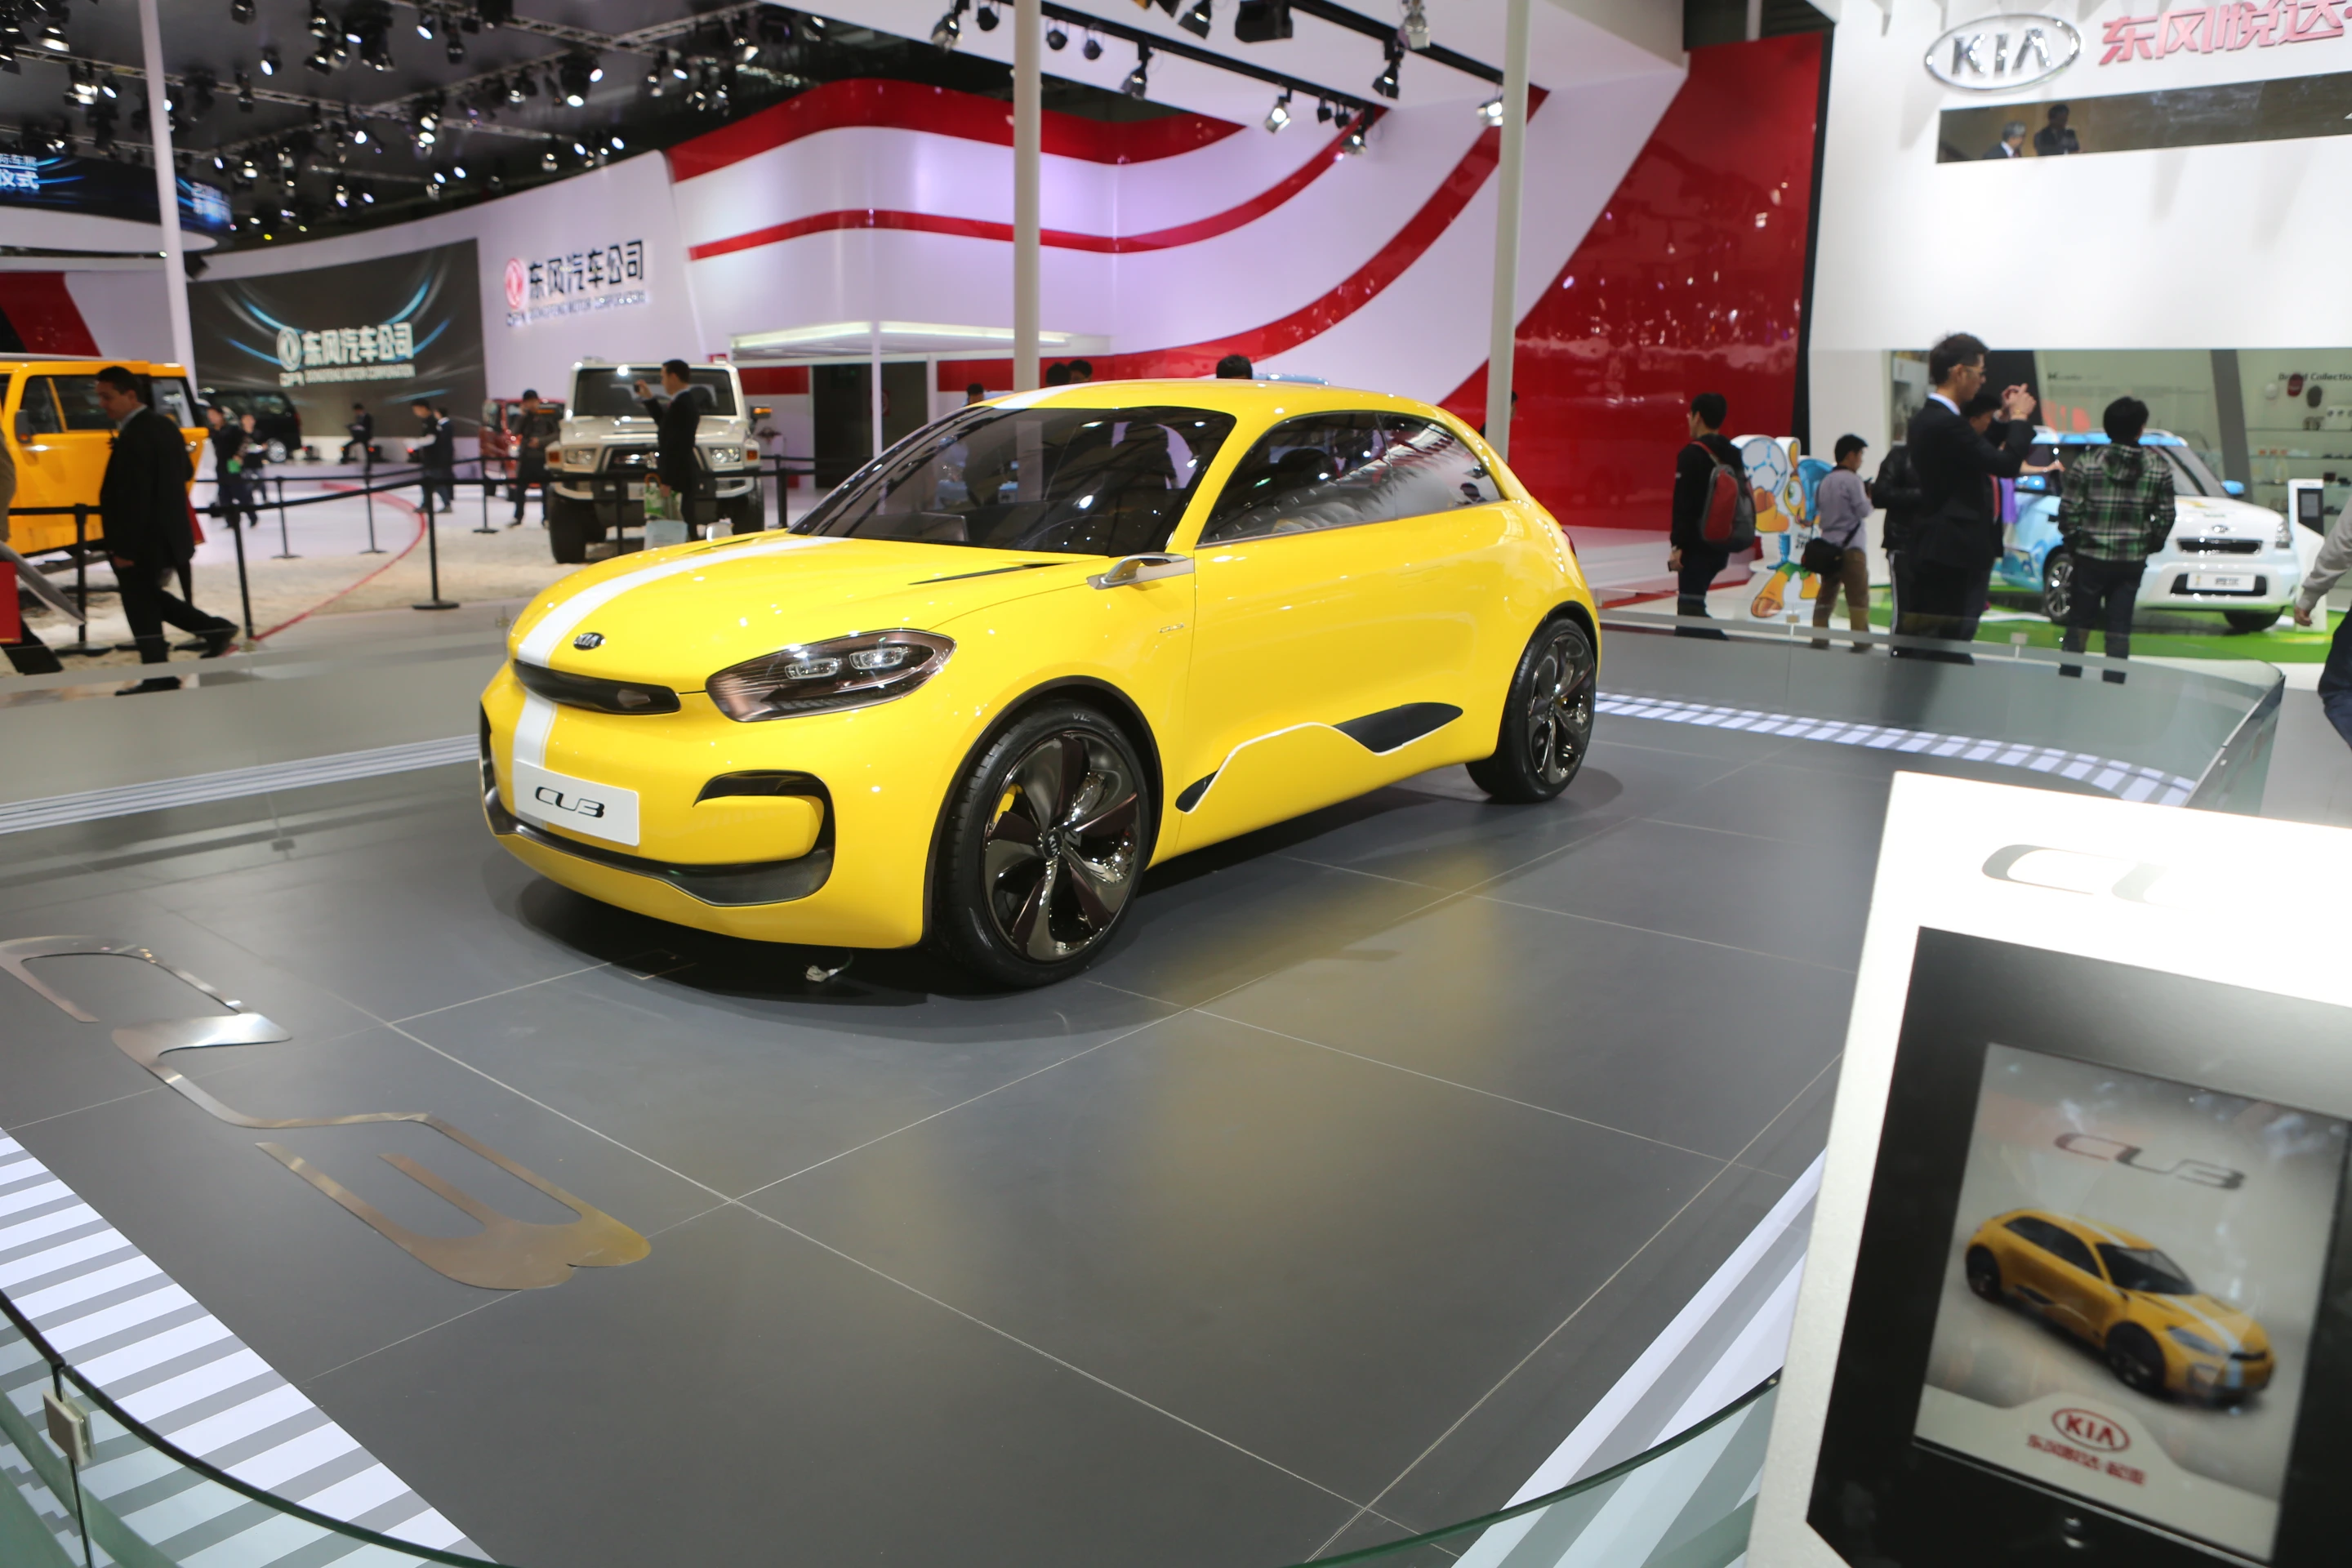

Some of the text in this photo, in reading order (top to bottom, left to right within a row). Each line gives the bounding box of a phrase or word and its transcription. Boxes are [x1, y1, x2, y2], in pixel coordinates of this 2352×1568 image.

[1951, 27, 2054, 78] KIA
[529, 239, 644, 300] 东风汽车公司
[301, 323, 414, 365] 东风汽车公司
[574, 634, 599, 648] KIA
[2065, 1414, 2115, 1448] KIA
